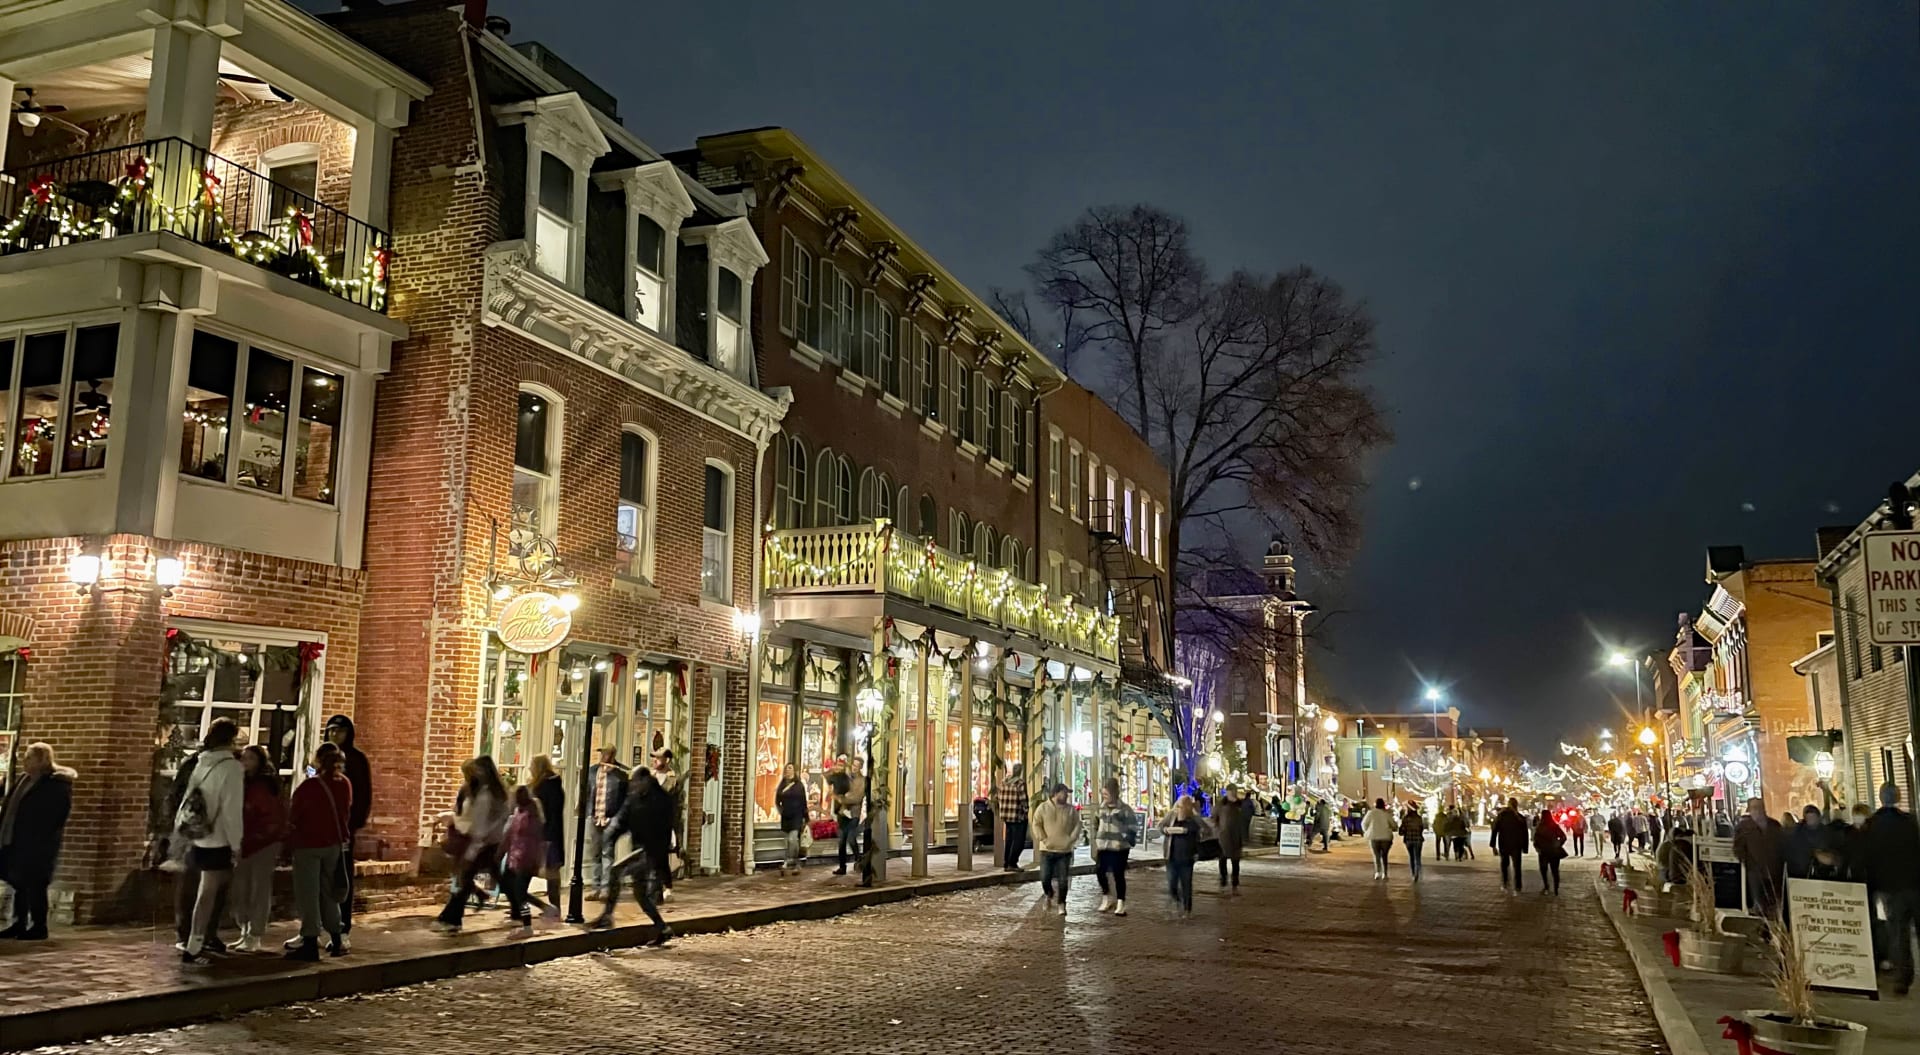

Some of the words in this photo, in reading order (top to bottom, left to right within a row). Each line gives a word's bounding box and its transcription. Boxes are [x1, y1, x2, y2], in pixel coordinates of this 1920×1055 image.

[1891, 540, 1920, 561] NO
[1879, 598, 1907, 613] THIS
[1876, 621, 1893, 636] OF
[1827, 918, 1839, 926] THE
[1841, 919, 1862, 928] NIGHT
